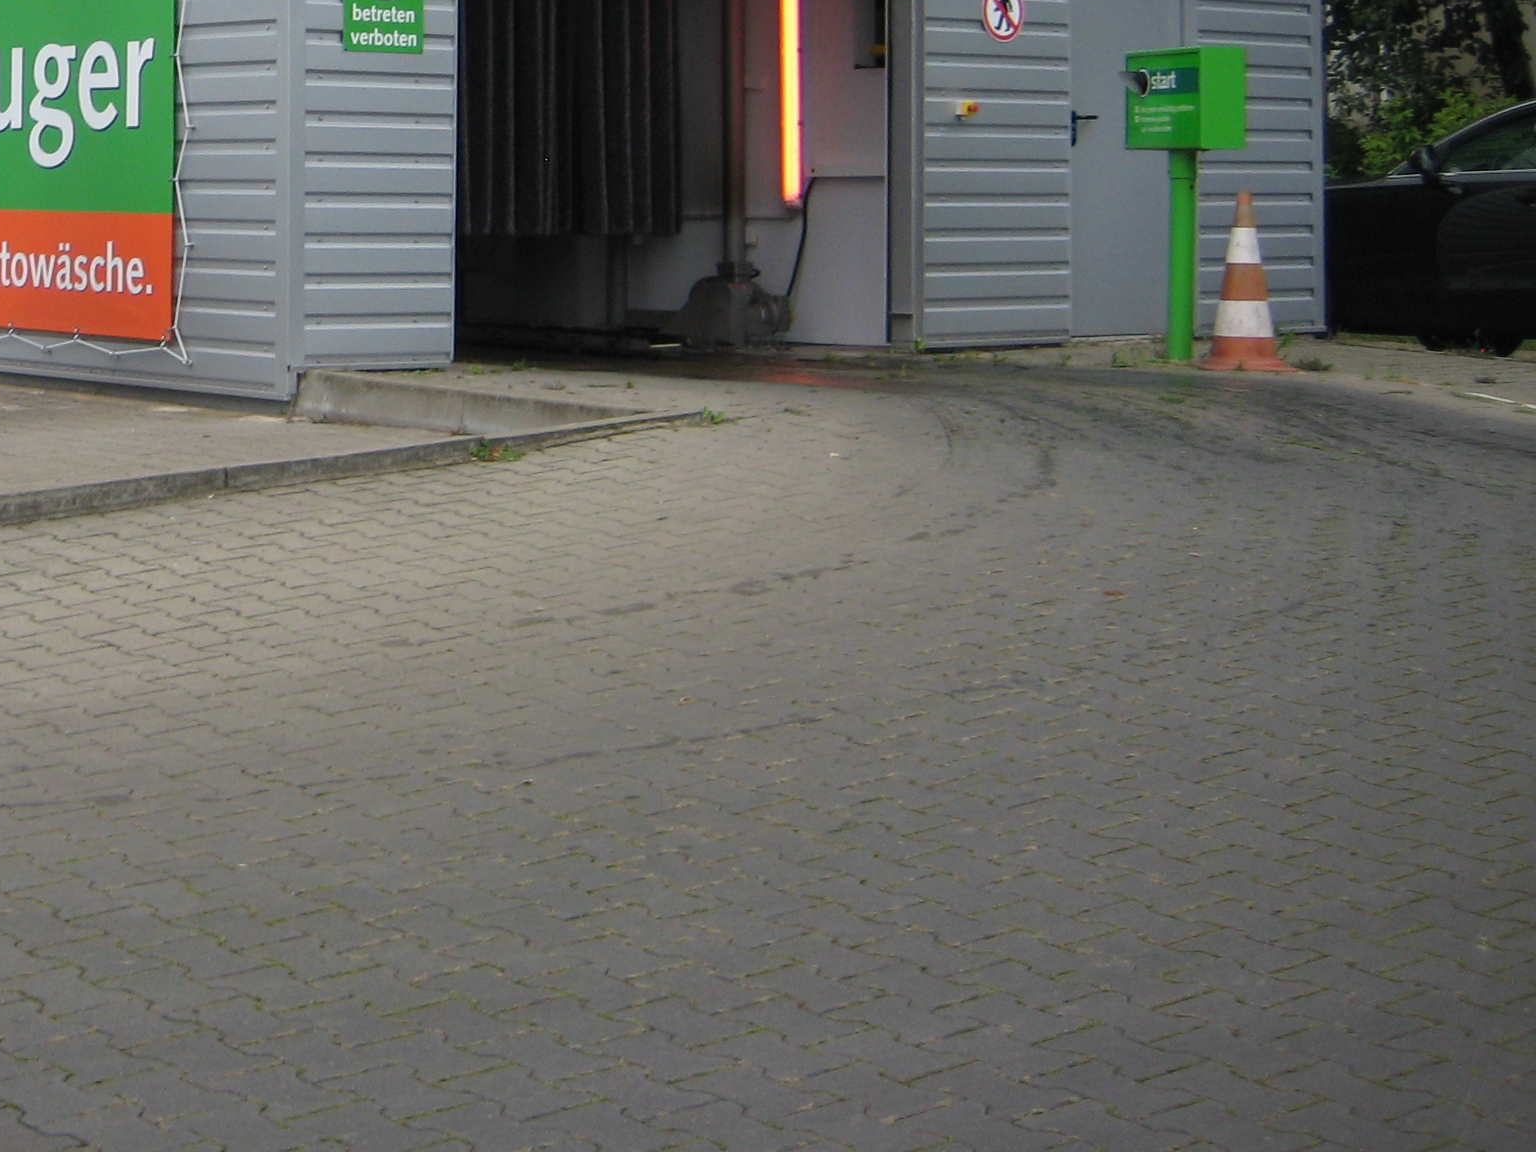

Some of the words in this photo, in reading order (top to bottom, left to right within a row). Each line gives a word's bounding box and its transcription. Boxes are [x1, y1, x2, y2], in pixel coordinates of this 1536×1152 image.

[352, 3, 415, 23] betreten
[350, 28, 418, 47] verboten
[1151, 71, 1177, 89] start
